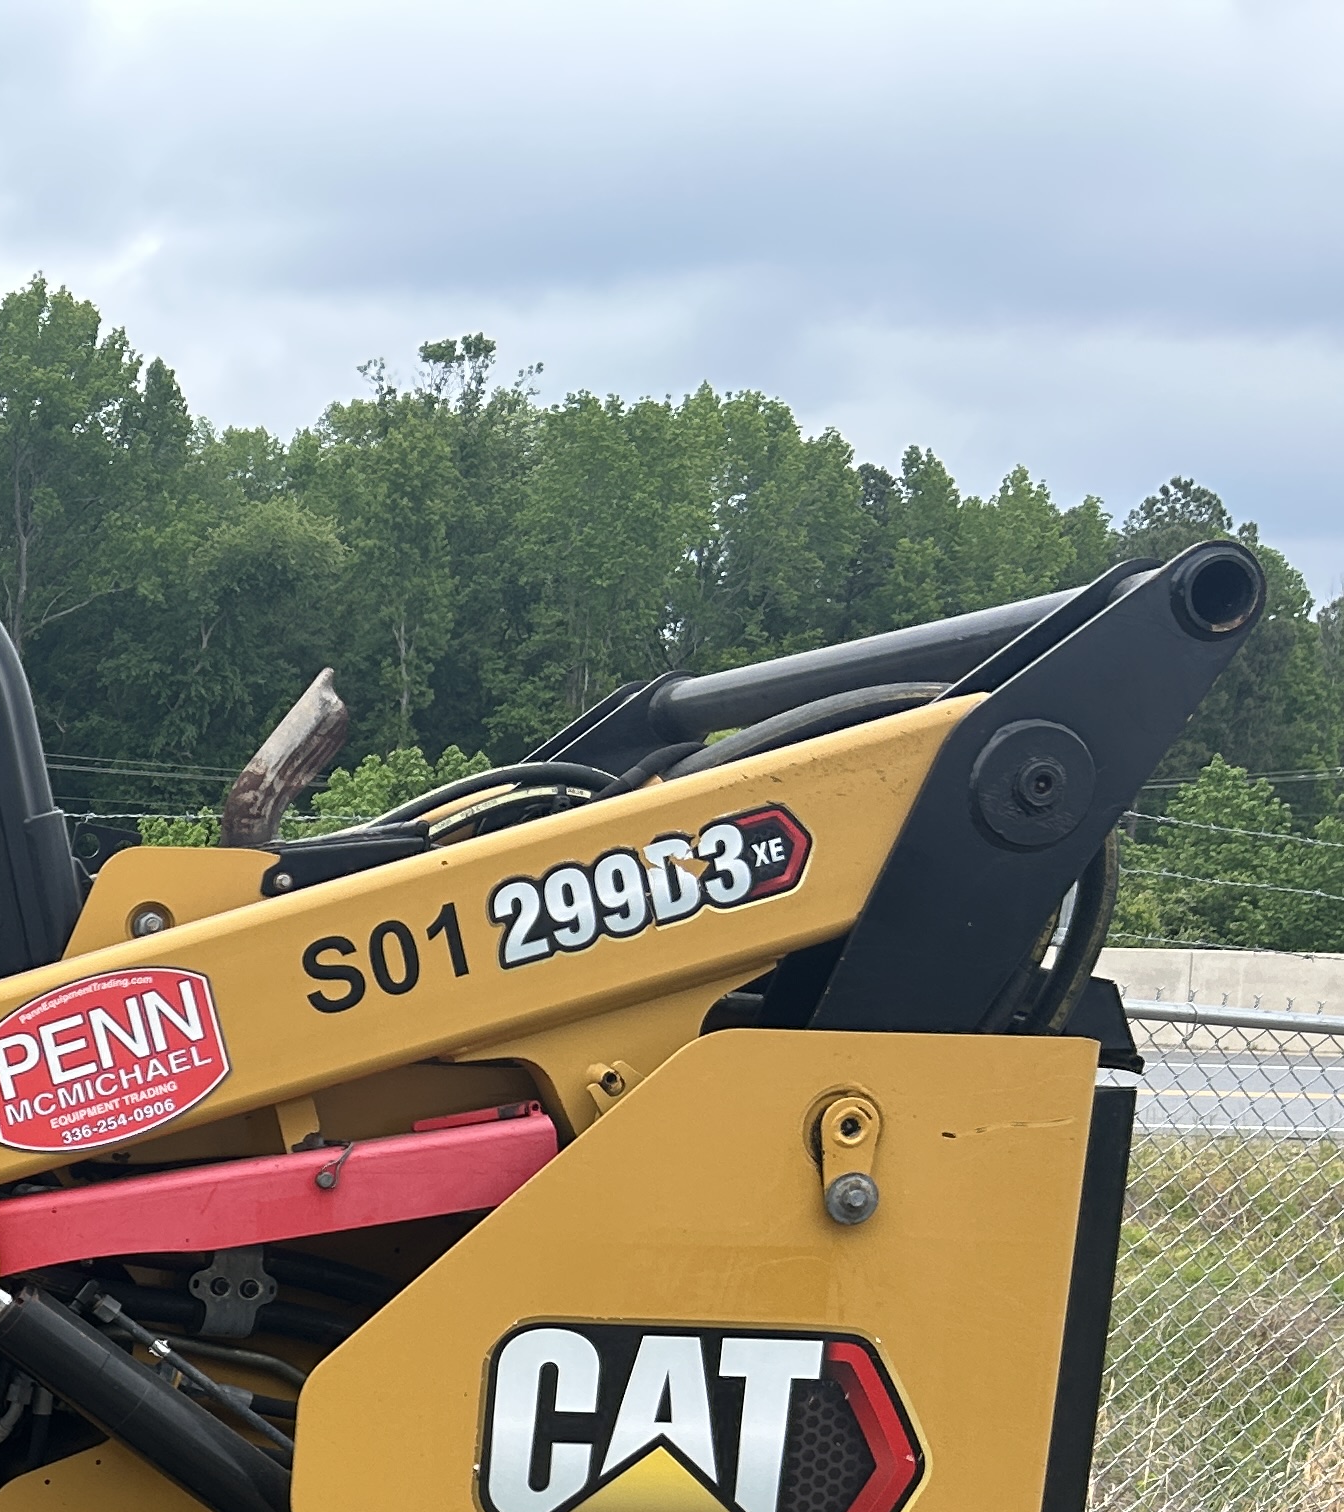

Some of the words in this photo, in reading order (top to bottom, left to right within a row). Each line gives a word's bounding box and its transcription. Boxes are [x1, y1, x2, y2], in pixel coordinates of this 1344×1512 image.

[493, 823, 752, 965] 299D3
[750, 837, 786, 868] XE
[301, 902, 471, 1014] S01
[18, 975, 154, 1024] PennEquipmentTrading.com
[4, 1046, 212, 1126] MCMICHAEL
[49, 1098, 120, 1129] EQUIPMENT
[122, 1081, 178, 1107] TRADING
[61, 1098, 176, 1145] 336-254-0906
